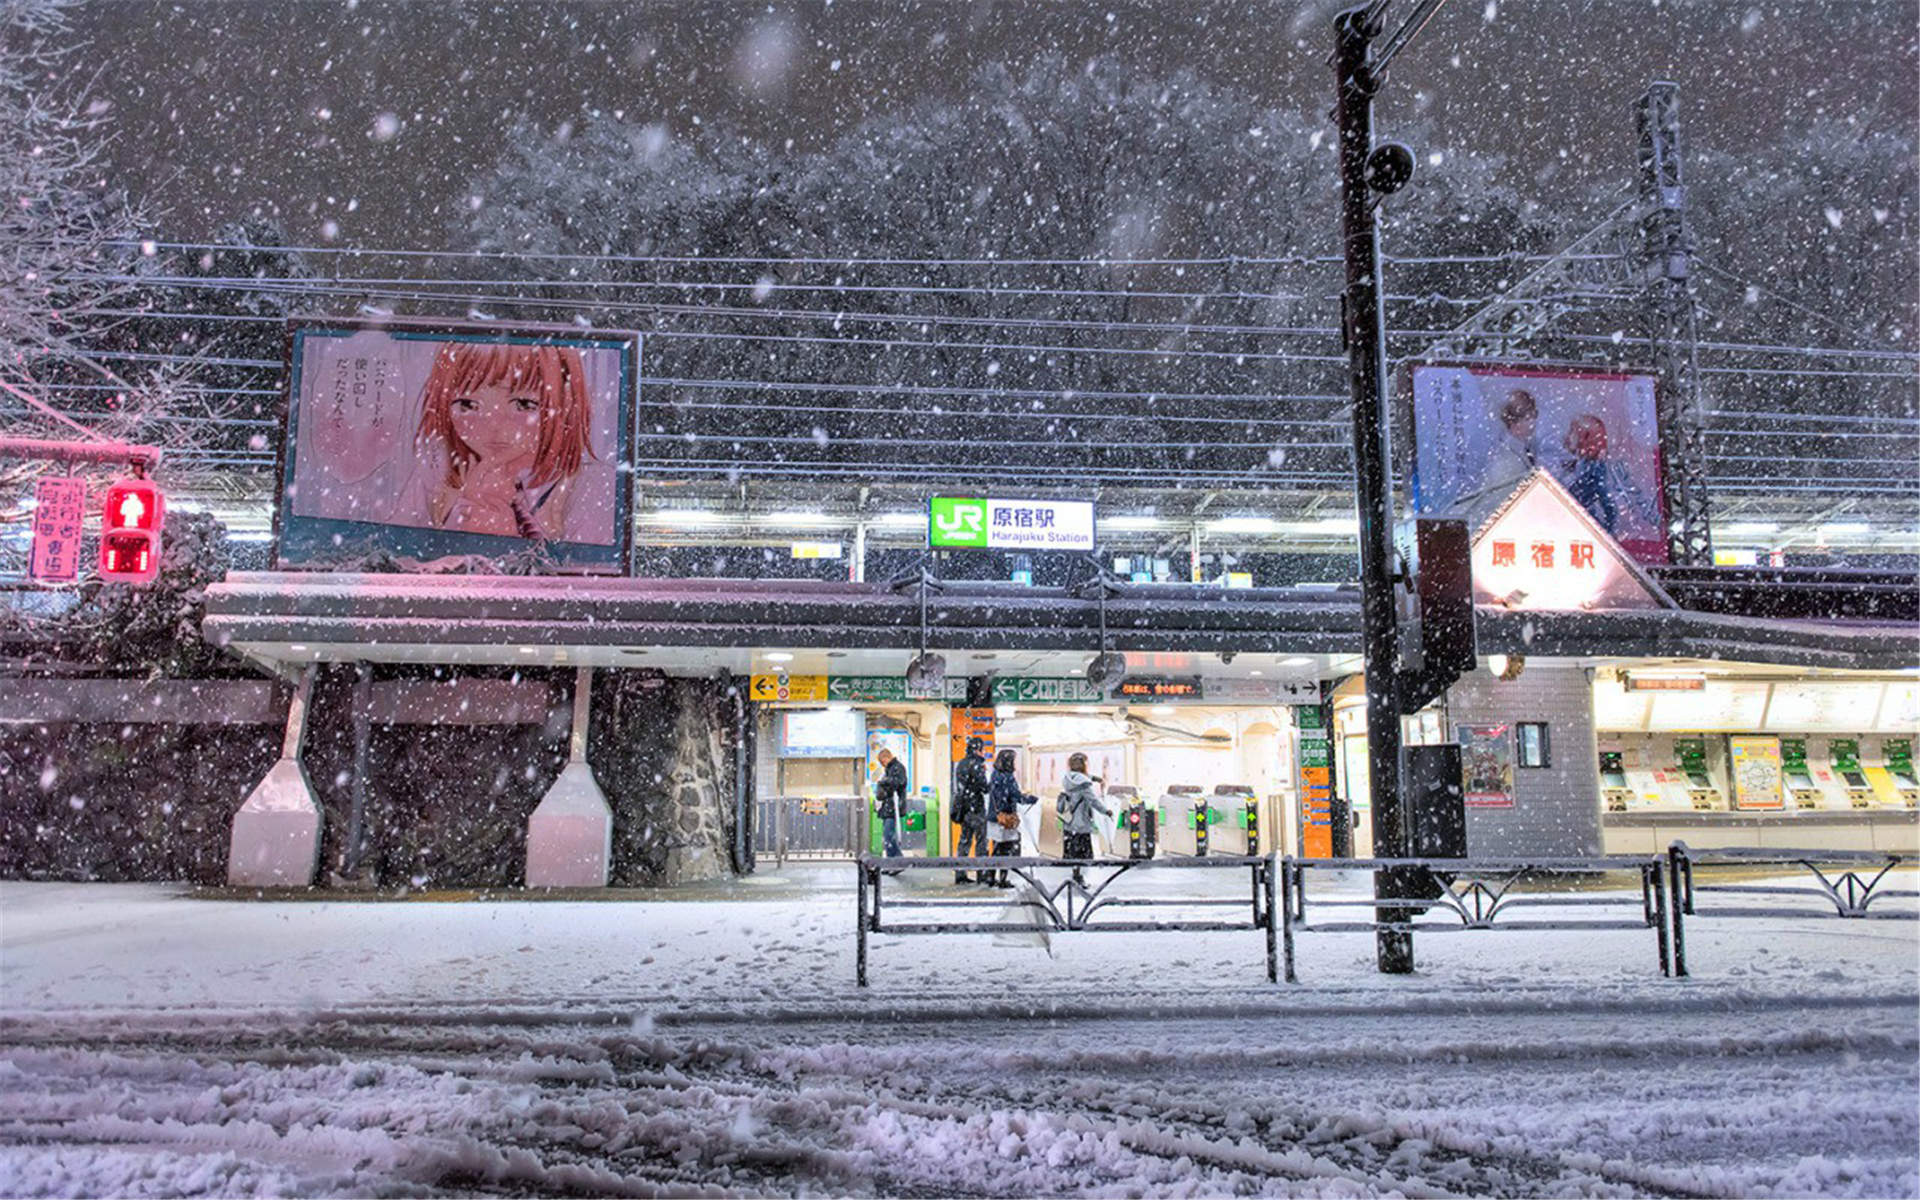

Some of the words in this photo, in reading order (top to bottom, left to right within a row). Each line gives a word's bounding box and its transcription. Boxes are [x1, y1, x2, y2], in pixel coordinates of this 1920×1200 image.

[352, 358, 368, 408] 使い回し
[936, 504, 983, 532] JR
[992, 507, 1056, 529] 原宿駅
[992, 530, 1045, 544] Harajuku
[1048, 532, 1089, 543] Station
[1491, 540, 1596, 570] 原宿駅
